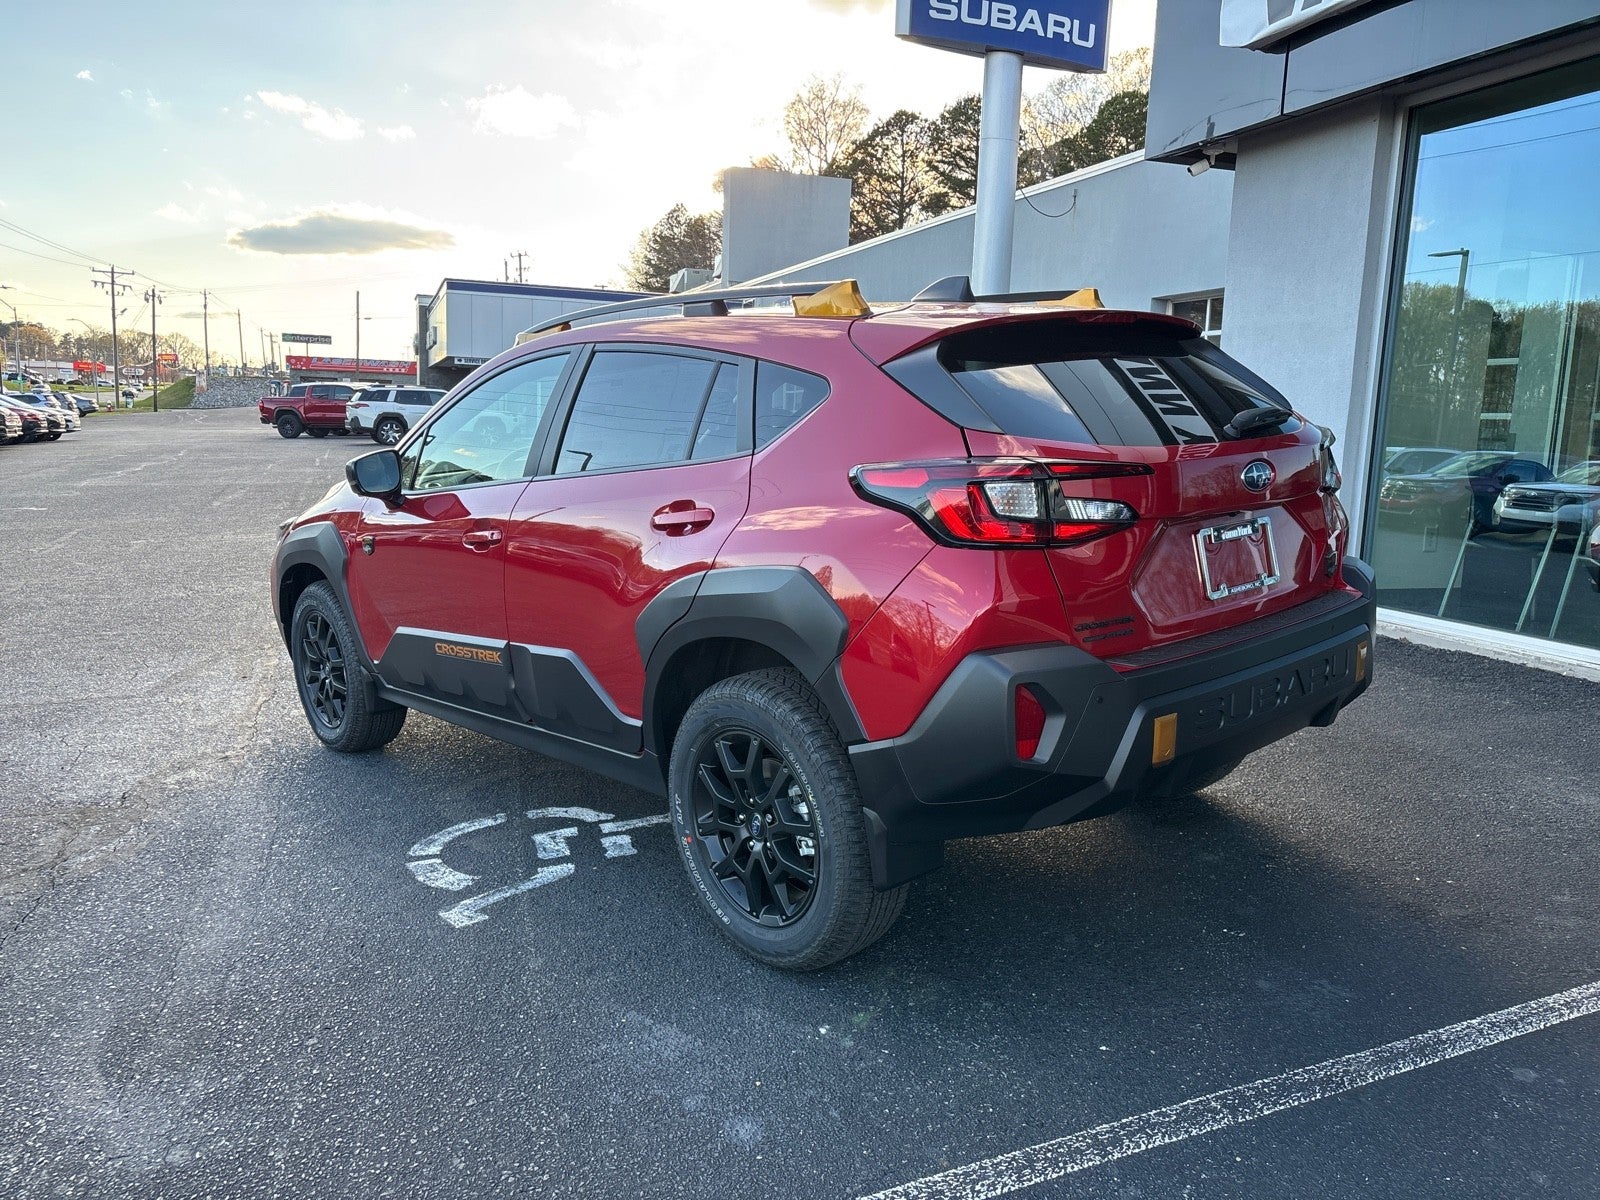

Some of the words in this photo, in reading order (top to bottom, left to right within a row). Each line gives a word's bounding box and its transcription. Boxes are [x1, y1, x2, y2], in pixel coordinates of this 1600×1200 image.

[928, 0, 1096, 49] SUBARU
[283, 334, 331, 343] enterprise
[434, 642, 503, 664] CROSSTREK
[1196, 650, 1349, 730] SUBARU
[680, 835, 731, 925] GEOLANDAR
